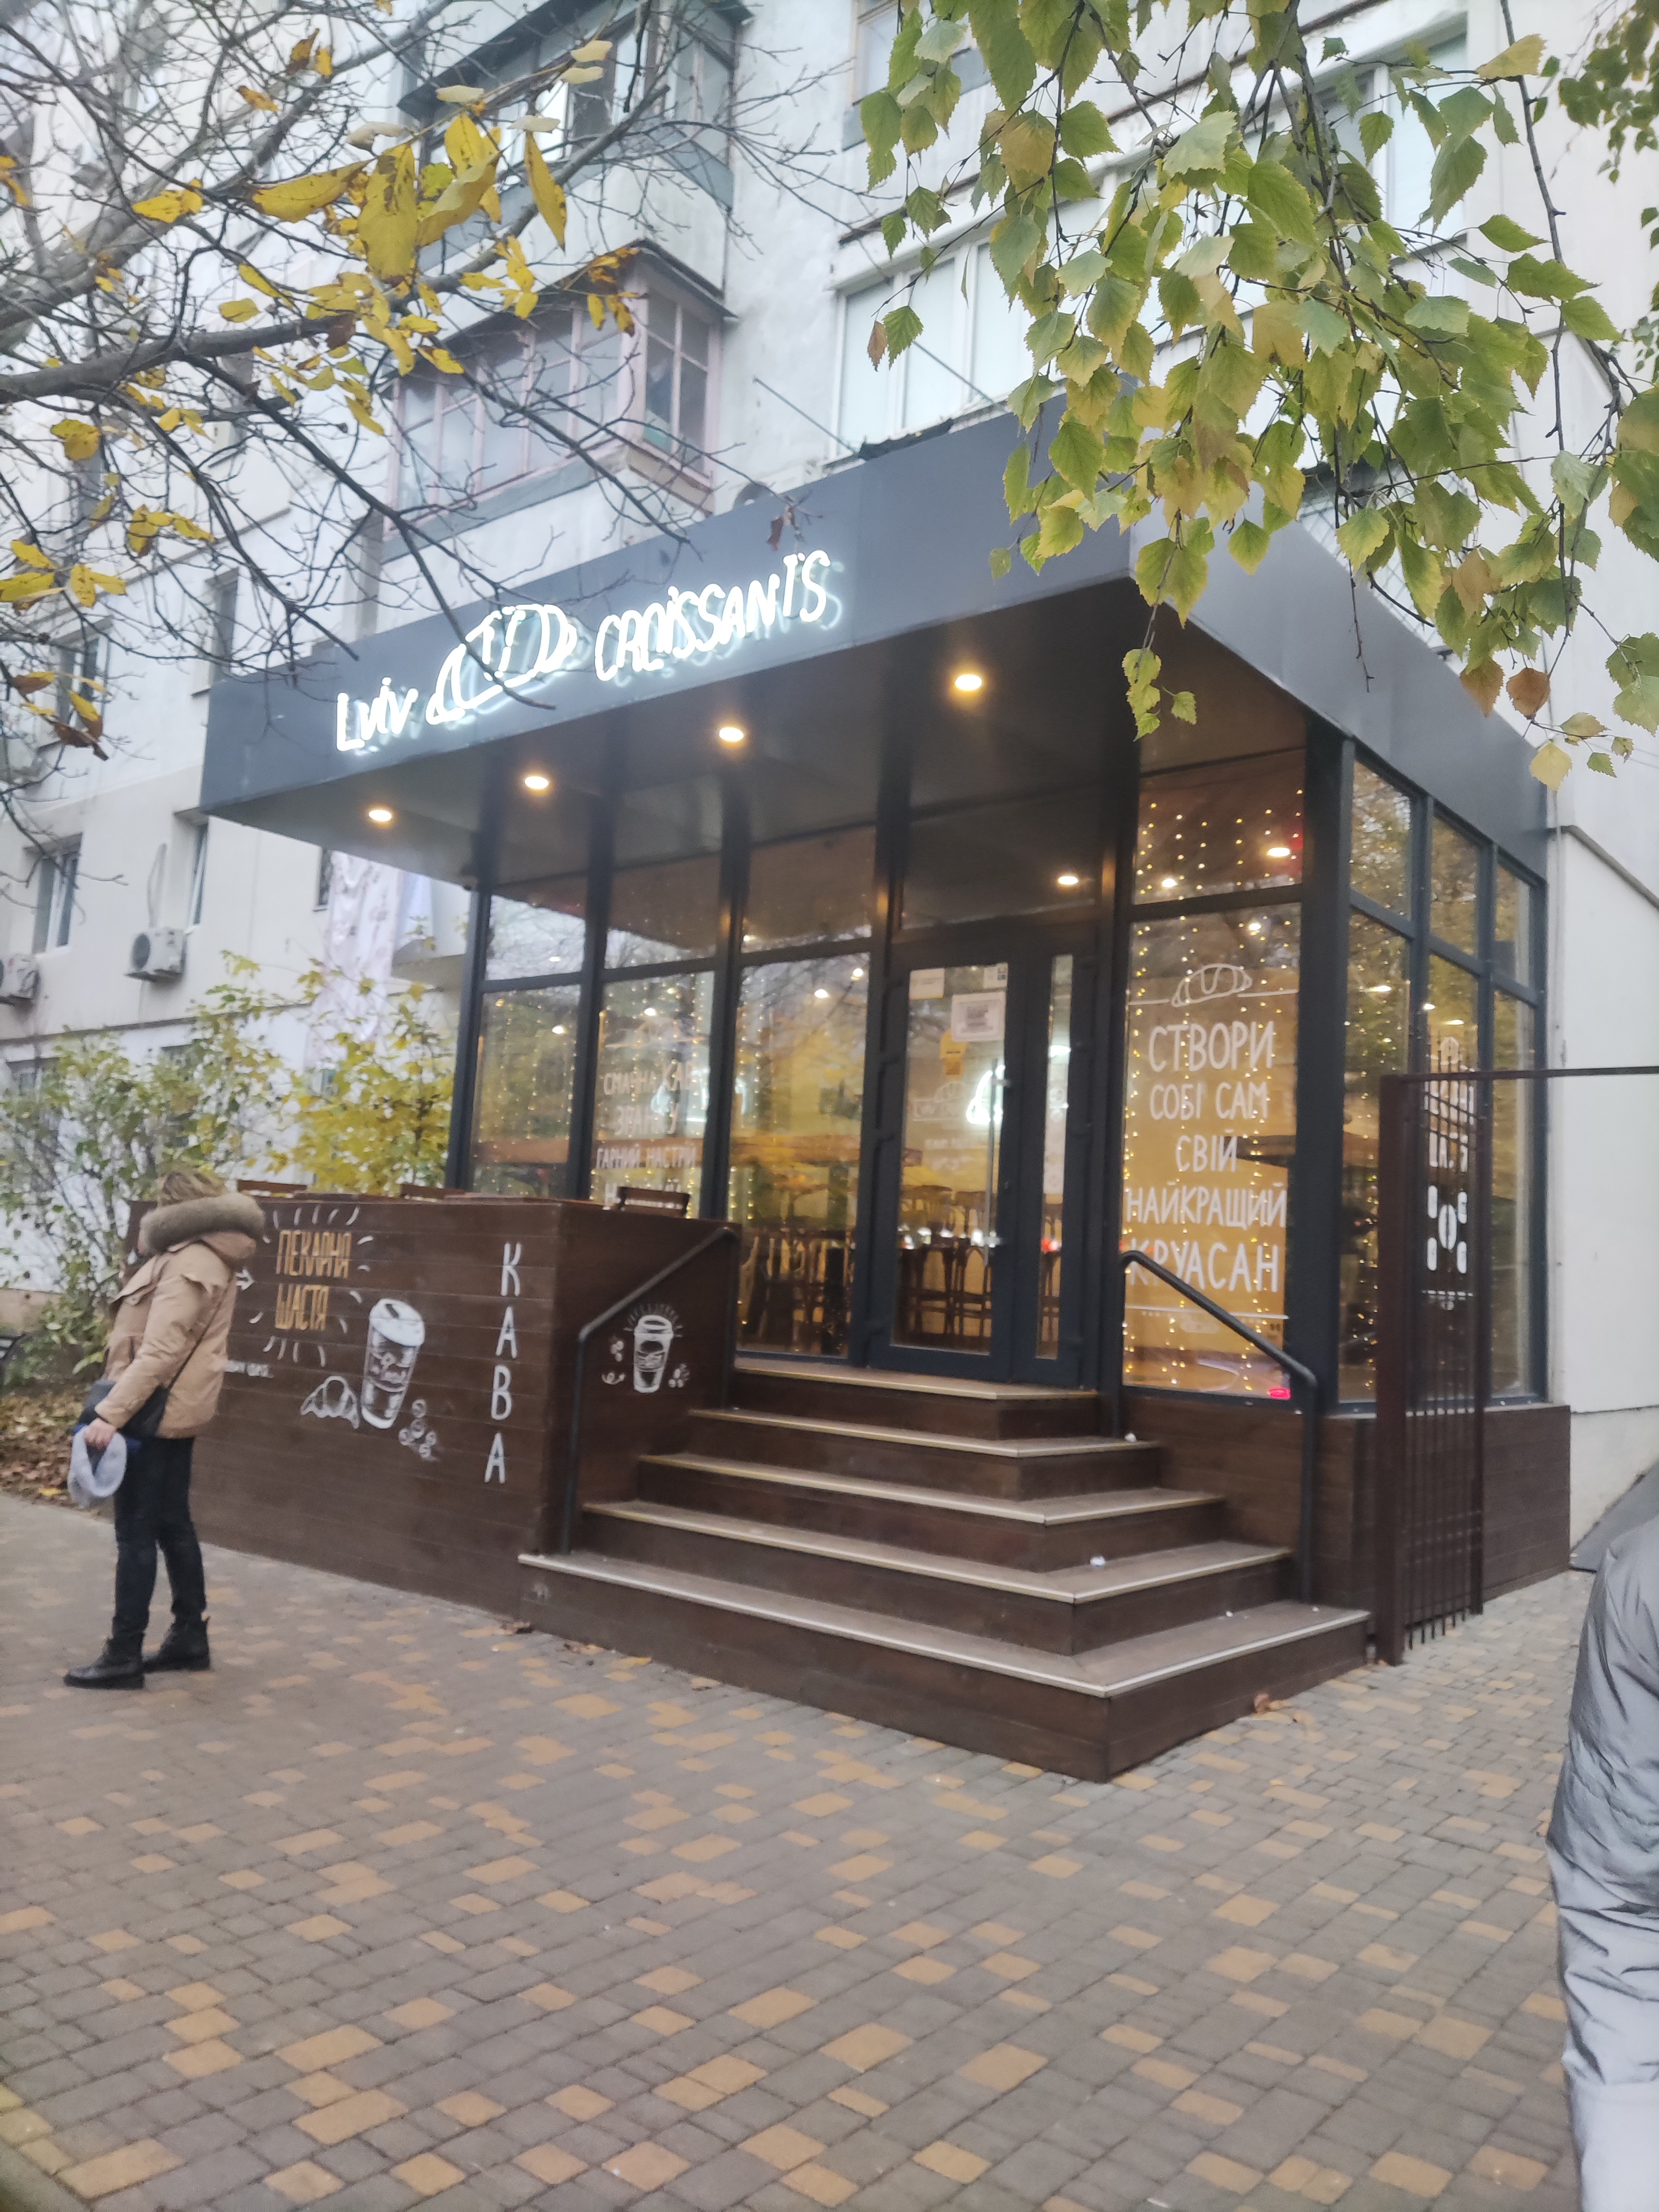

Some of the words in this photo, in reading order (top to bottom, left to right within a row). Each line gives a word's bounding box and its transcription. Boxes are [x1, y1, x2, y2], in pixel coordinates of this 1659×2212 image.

[1149, 1020, 1275, 1072] СТВОРИ
[1150, 1082, 1202, 1120] СОБІ
[1215, 1081, 1268, 1119] САМ
[1176, 1128, 1239, 1173] СВІЙ
[1126, 1181, 1287, 1230] НАЙКРАЩИЙ
[1129, 1237, 1279, 1293] КРУАСАН
[484, 1241, 523, 1485] КАВА
